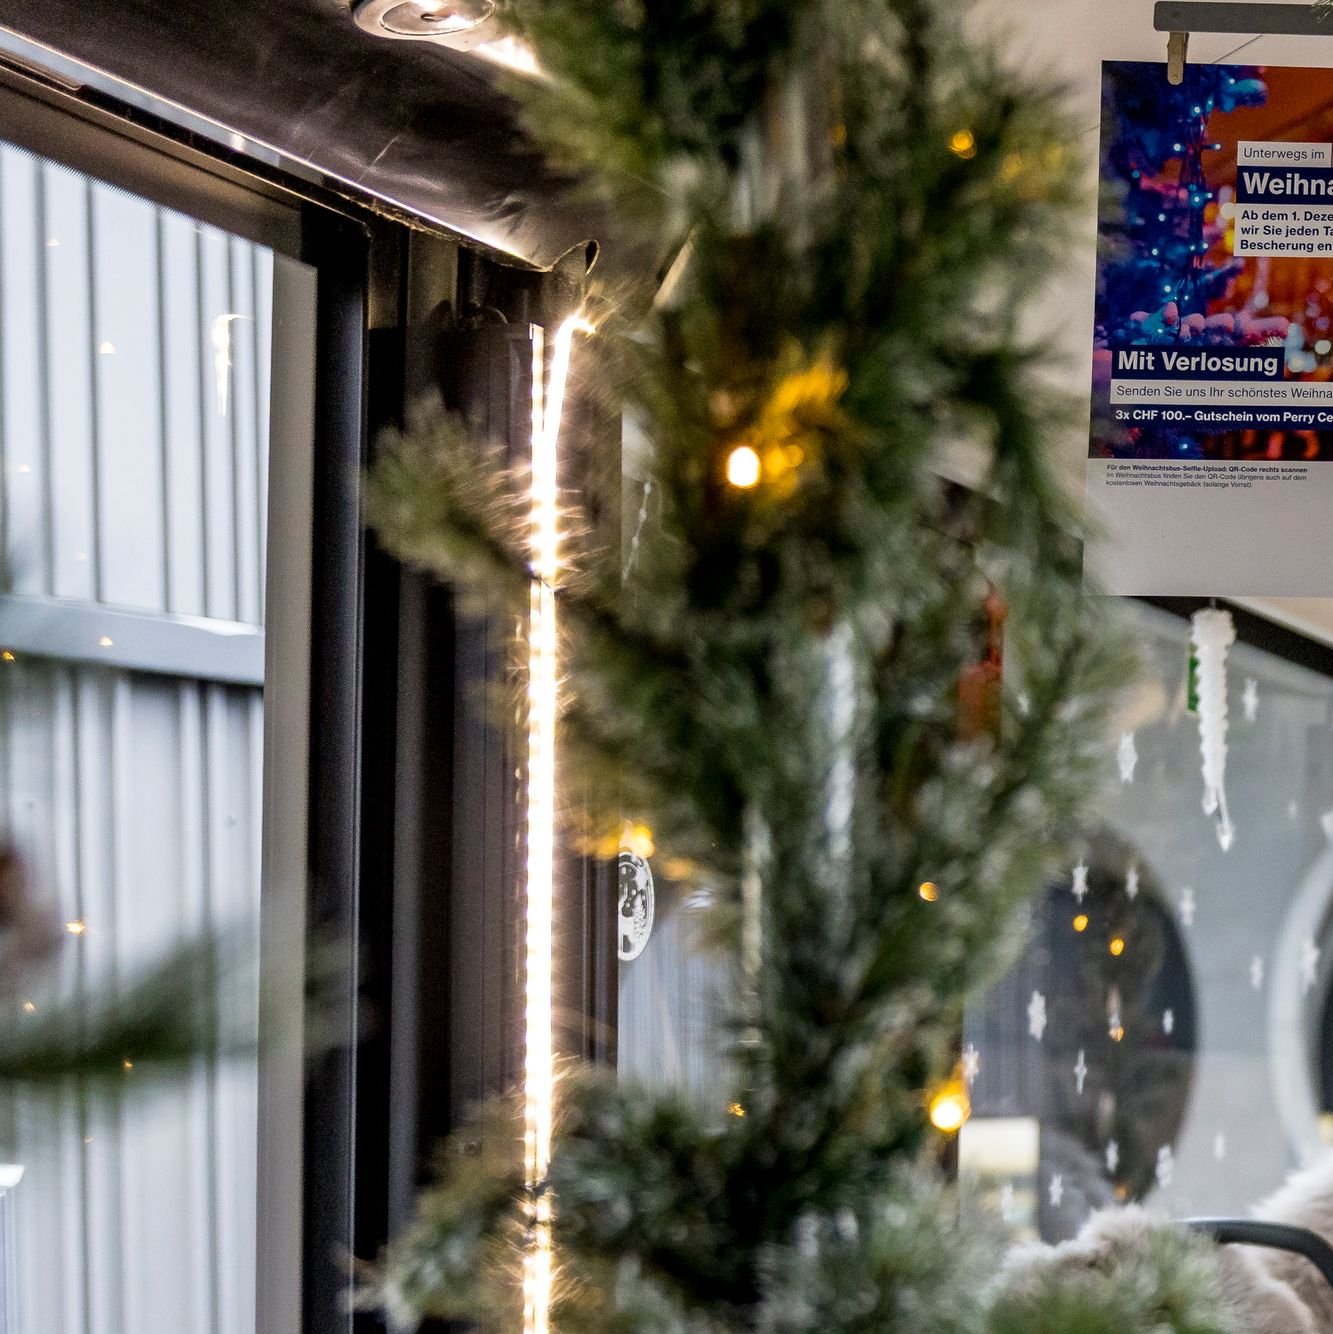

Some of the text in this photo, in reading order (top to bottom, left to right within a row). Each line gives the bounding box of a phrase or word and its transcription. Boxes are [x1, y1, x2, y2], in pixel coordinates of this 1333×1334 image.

[1243, 148, 1325, 161] Unterwegs im
[1241, 210, 1259, 221] Ab
[1261, 210, 1288, 221] dem
[1291, 211, 1300, 221] 1.
[1241, 225, 1259, 236] wir
[1263, 225, 1282, 236] Sie
[1284, 225, 1319, 238] jeden
[1240, 240, 1314, 253] Bescherung
[1117, 351, 1278, 377] Mit Verlosung
[1116, 385, 1161, 397] Senden
[1163, 386, 1183, 397] Sie
[1185, 388, 1206, 397] uns
[1209, 386, 1224, 398] Ihr
[1227, 387, 1287, 398] schönstes
[1115, 410, 1130, 420] 3x
[1132, 410, 1158, 420] CHF
[1194, 411, 1253, 422] Gutschein
[1256, 413, 1281, 422] vom
[1283, 412, 1315, 424] Perry
[1207, 473, 1237, 481] QR-Code
[1143, 480, 1201, 488] Weihnachtsgebäck
[1203, 481, 1230, 489] (solange
